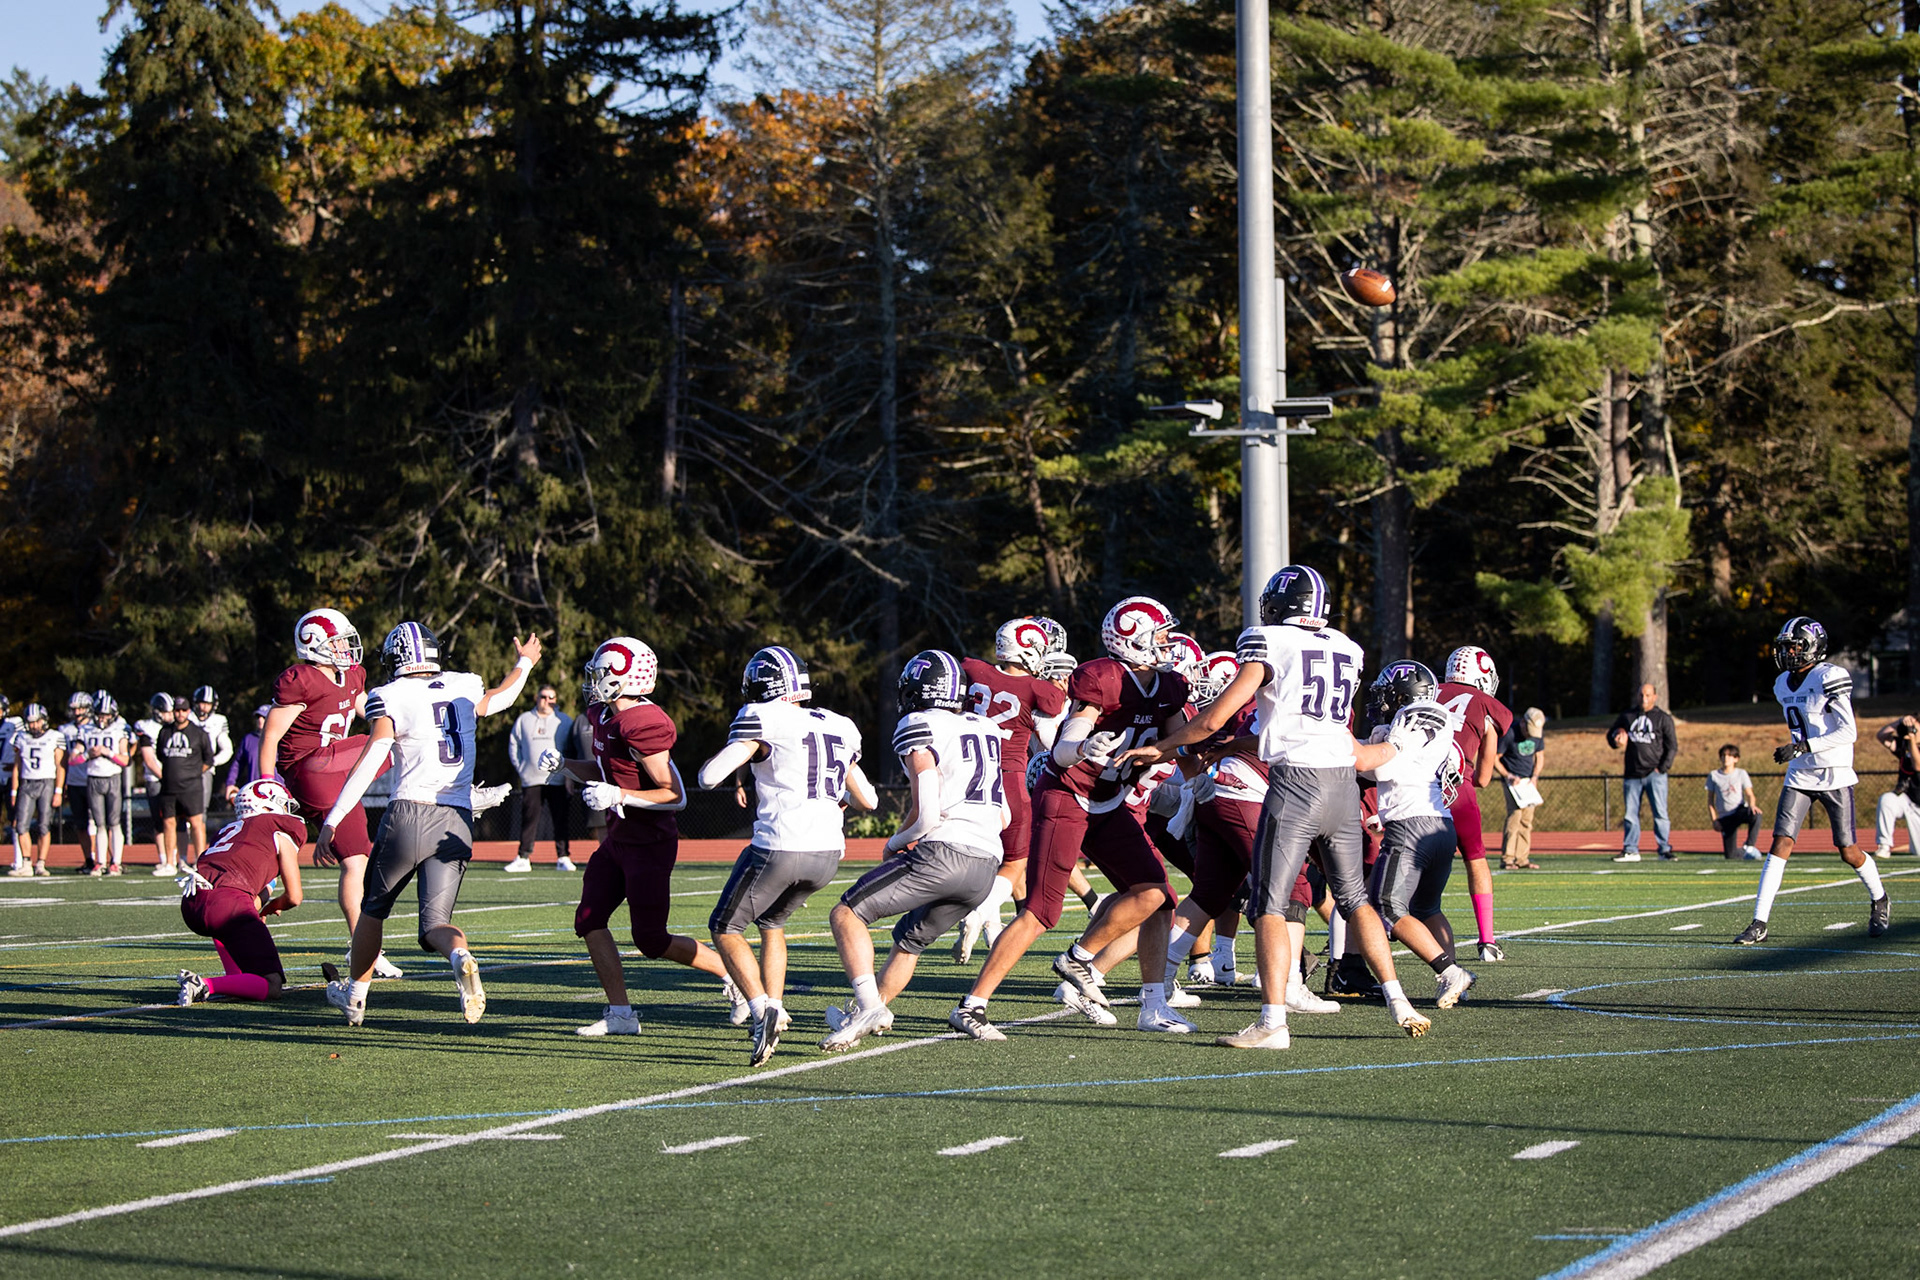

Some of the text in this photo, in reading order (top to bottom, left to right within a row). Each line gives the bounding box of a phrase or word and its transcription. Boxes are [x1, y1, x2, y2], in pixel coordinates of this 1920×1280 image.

[934, 699, 963, 709] Riddell
[969, 683, 1021, 741] 32
[1301, 650, 1354, 724] 55
[30, 747, 40, 769] 5
[432, 701, 464, 767] 3
[802, 732, 846, 801] 15
[960, 734, 1003, 808] 22
[204, 820, 245, 855] 2
